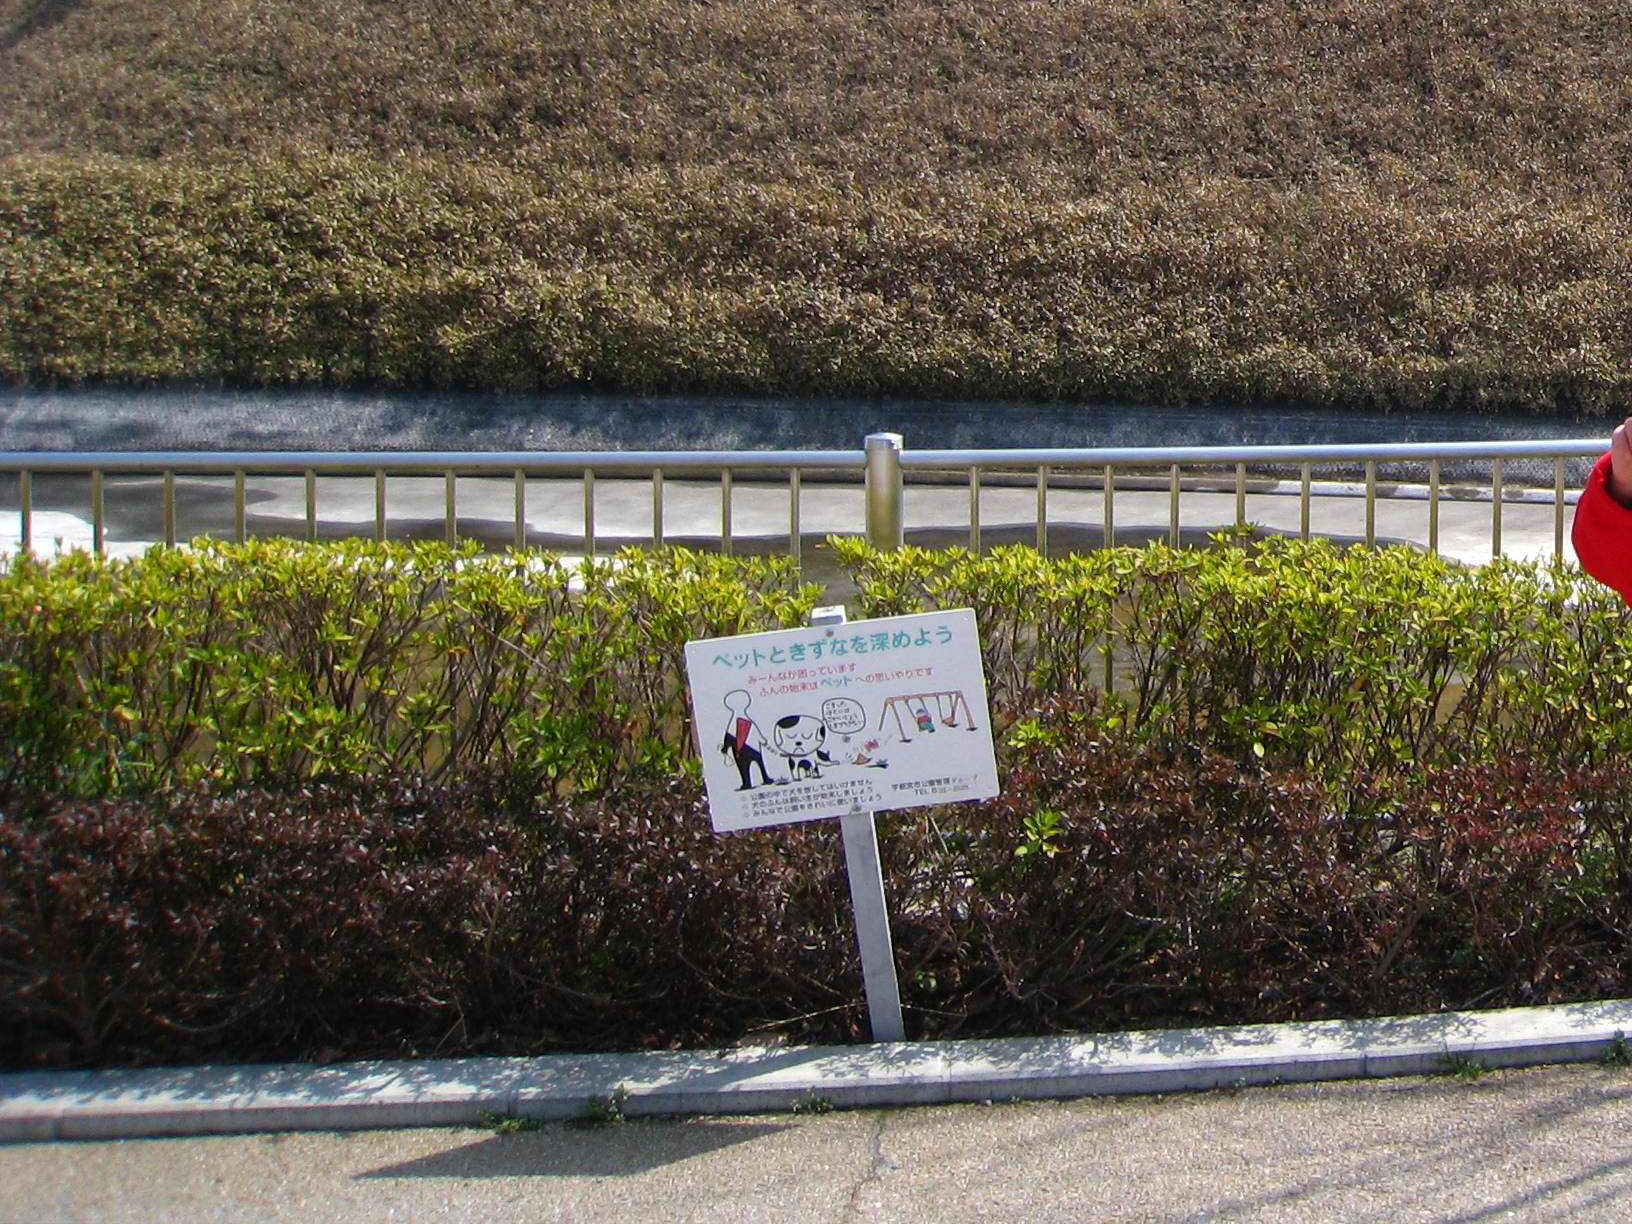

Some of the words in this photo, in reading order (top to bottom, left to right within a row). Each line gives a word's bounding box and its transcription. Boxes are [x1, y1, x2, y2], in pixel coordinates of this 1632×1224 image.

[712, 624, 954, 669] ペットときずなを深めよう
[748, 662, 857, 685] みーんなが困っています
